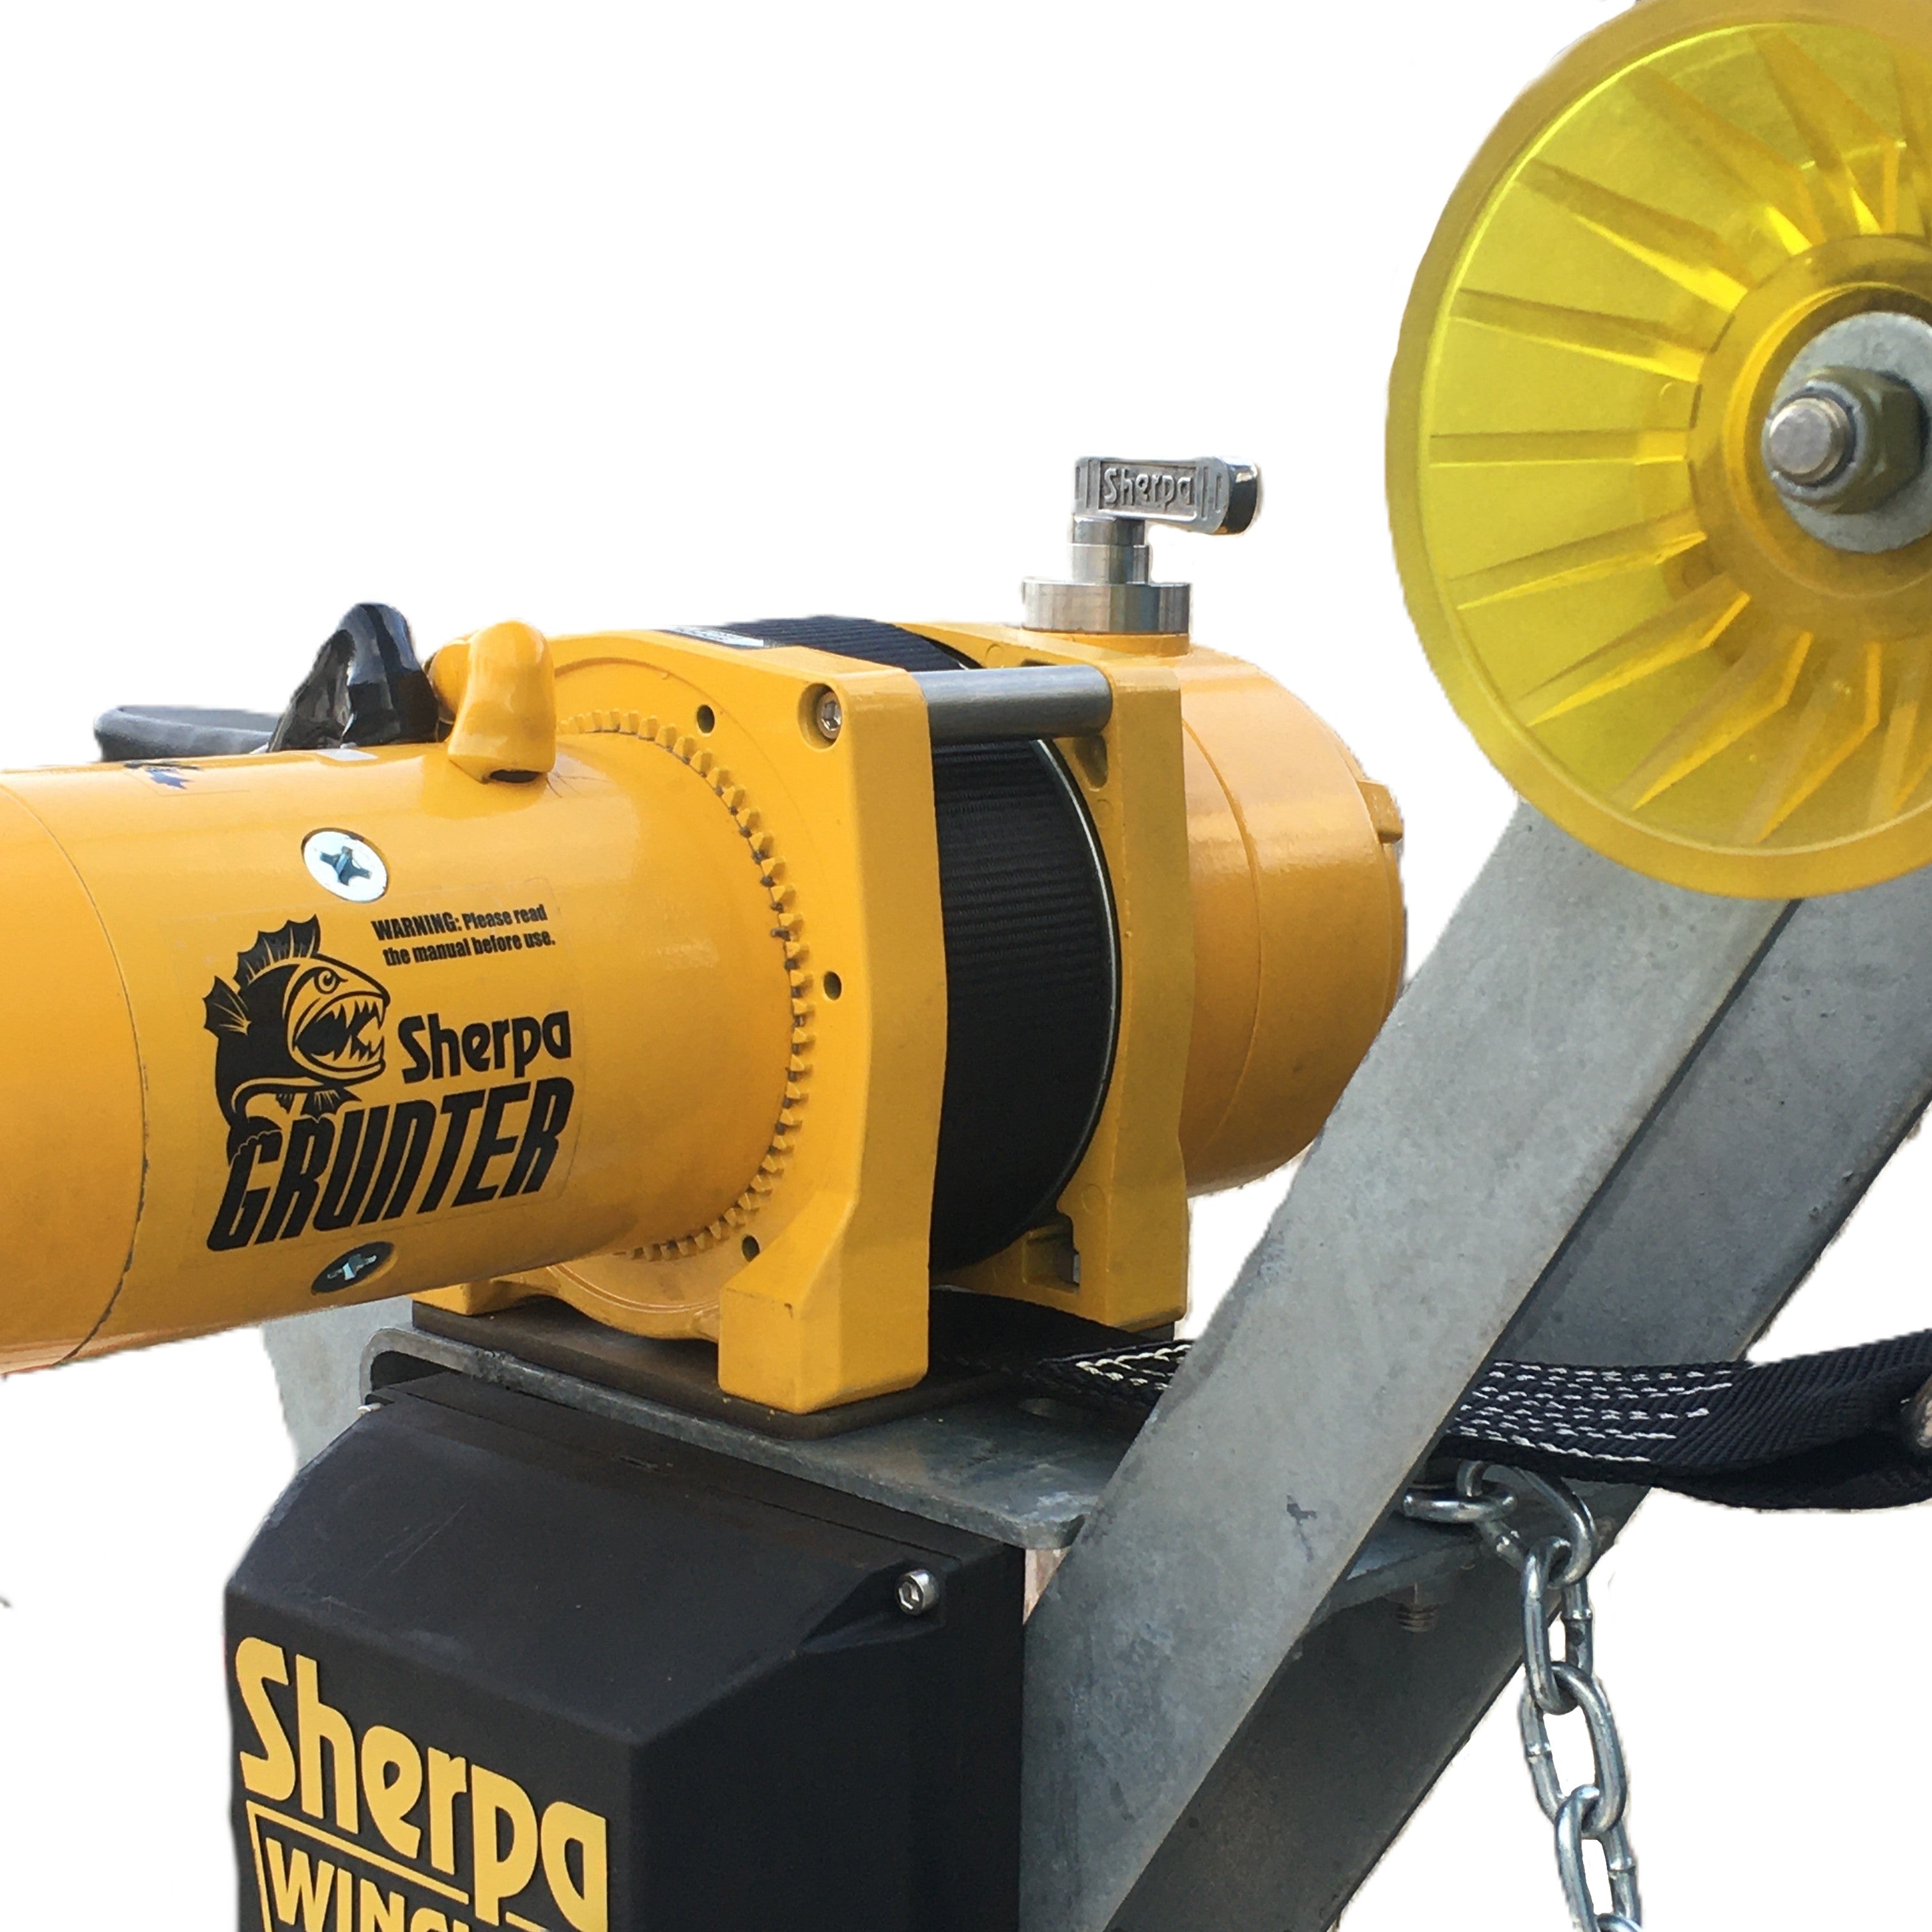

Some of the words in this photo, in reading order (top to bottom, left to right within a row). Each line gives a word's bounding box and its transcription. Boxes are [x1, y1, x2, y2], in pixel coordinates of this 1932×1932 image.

[1103, 467, 1195, 510] Sherpa
[371, 912, 462, 940] WARNING:
[461, 910, 512, 930] Please
[512, 903, 548, 924] read
[383, 947, 411, 967] the
[411, 938, 472, 963] manual
[471, 934, 523, 955] before
[523, 930, 556, 949] use.
[397, 1010, 572, 1084] Sherpa
[206, 1077, 574, 1251] GRUNTER
[234, 1637, 608, 1932] Sherpa
[265, 1837, 470, 1932] WIN
